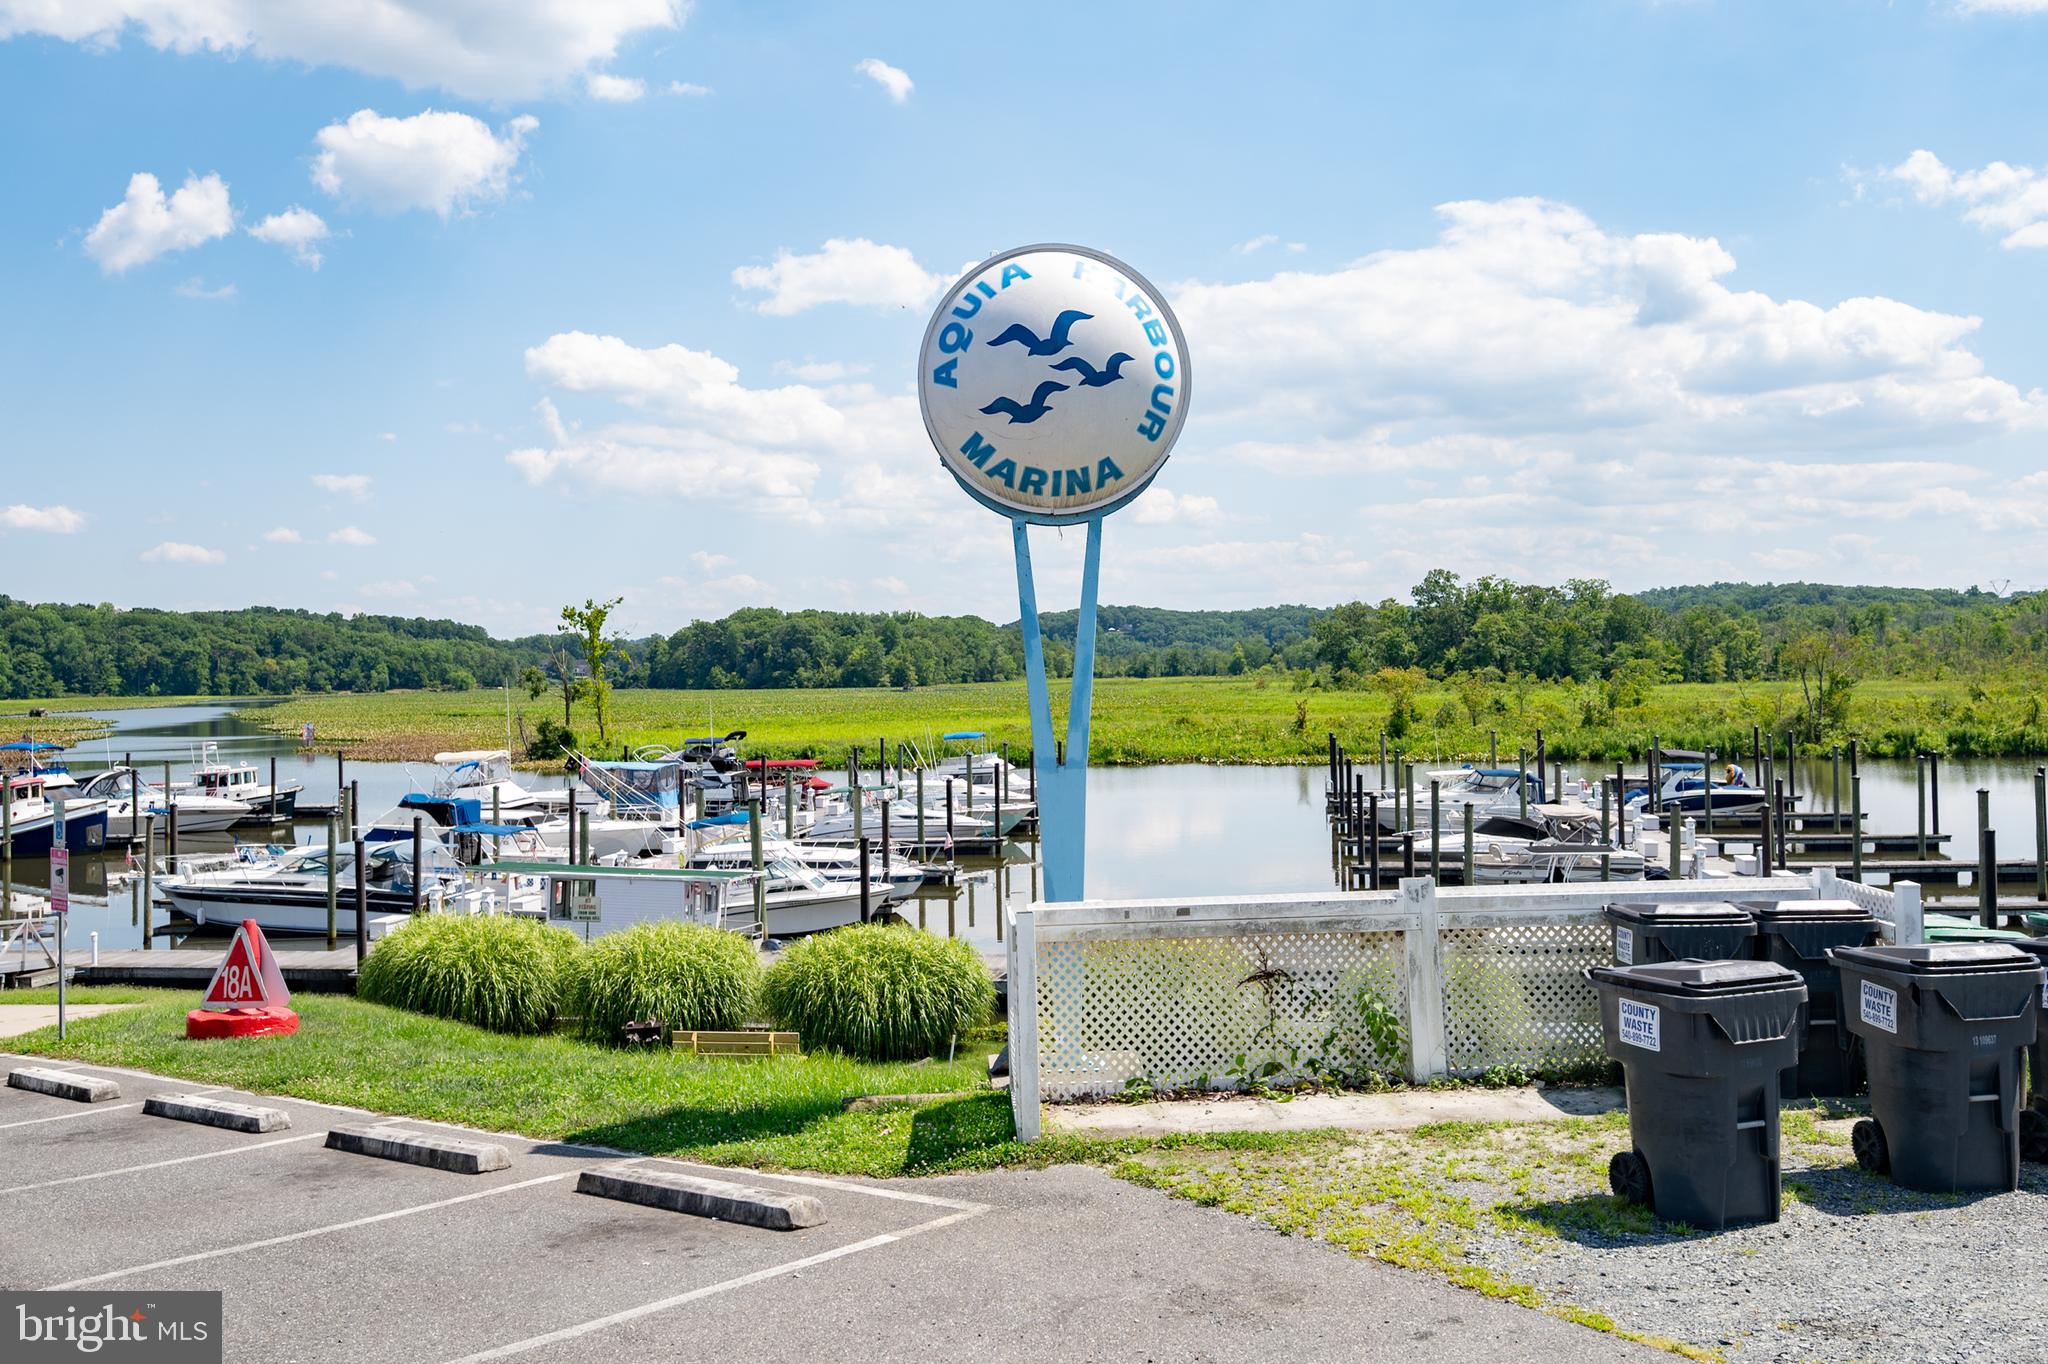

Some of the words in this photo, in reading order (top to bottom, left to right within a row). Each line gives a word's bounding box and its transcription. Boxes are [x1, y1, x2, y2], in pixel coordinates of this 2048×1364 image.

[933, 262, 1032, 389] AQUIA
[959, 431, 1125, 497] MARINA
[221, 965, 252, 999] 18A
[1863, 984, 1894, 1004] COUNTY
[1621, 1002, 1656, 1021] COUNTY
[1864, 997, 1891, 1017] WASTE
[1623, 1016, 1653, 1035] WASTE
